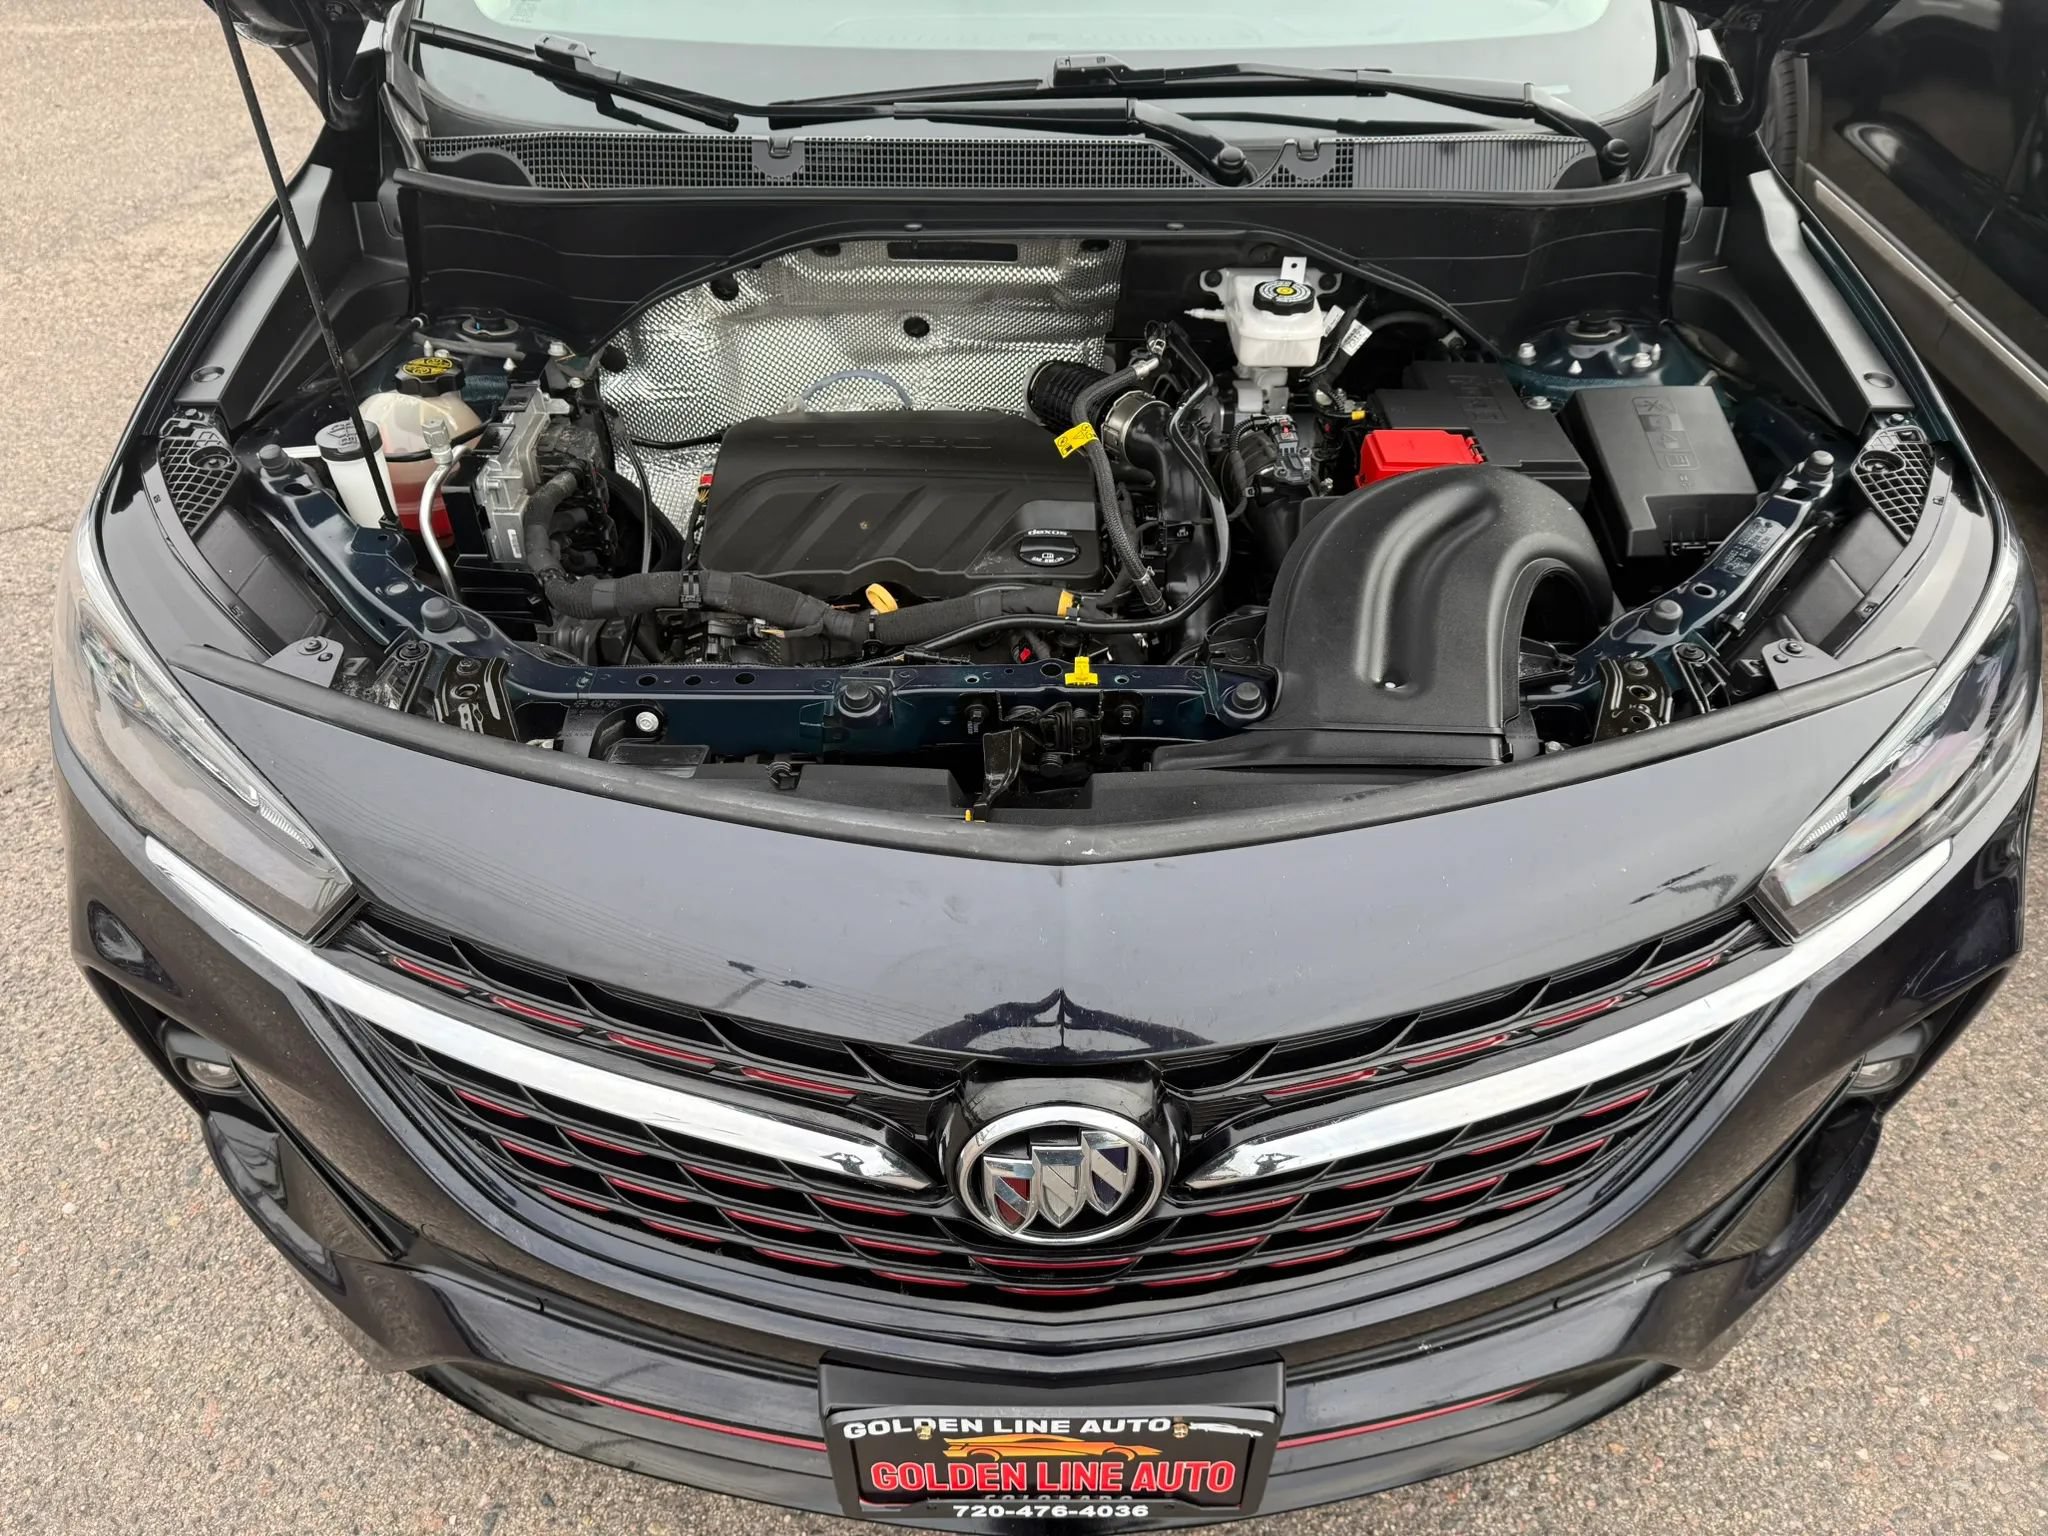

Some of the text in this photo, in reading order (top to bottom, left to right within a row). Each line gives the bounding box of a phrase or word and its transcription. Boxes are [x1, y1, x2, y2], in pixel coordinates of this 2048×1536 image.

[843, 1418, 1171, 1439] GOLDEN LINE AUTO
[871, 1460, 1236, 1493] GOLDEN LINE AUTO
[953, 1505, 1149, 1517] 720-476-4036
